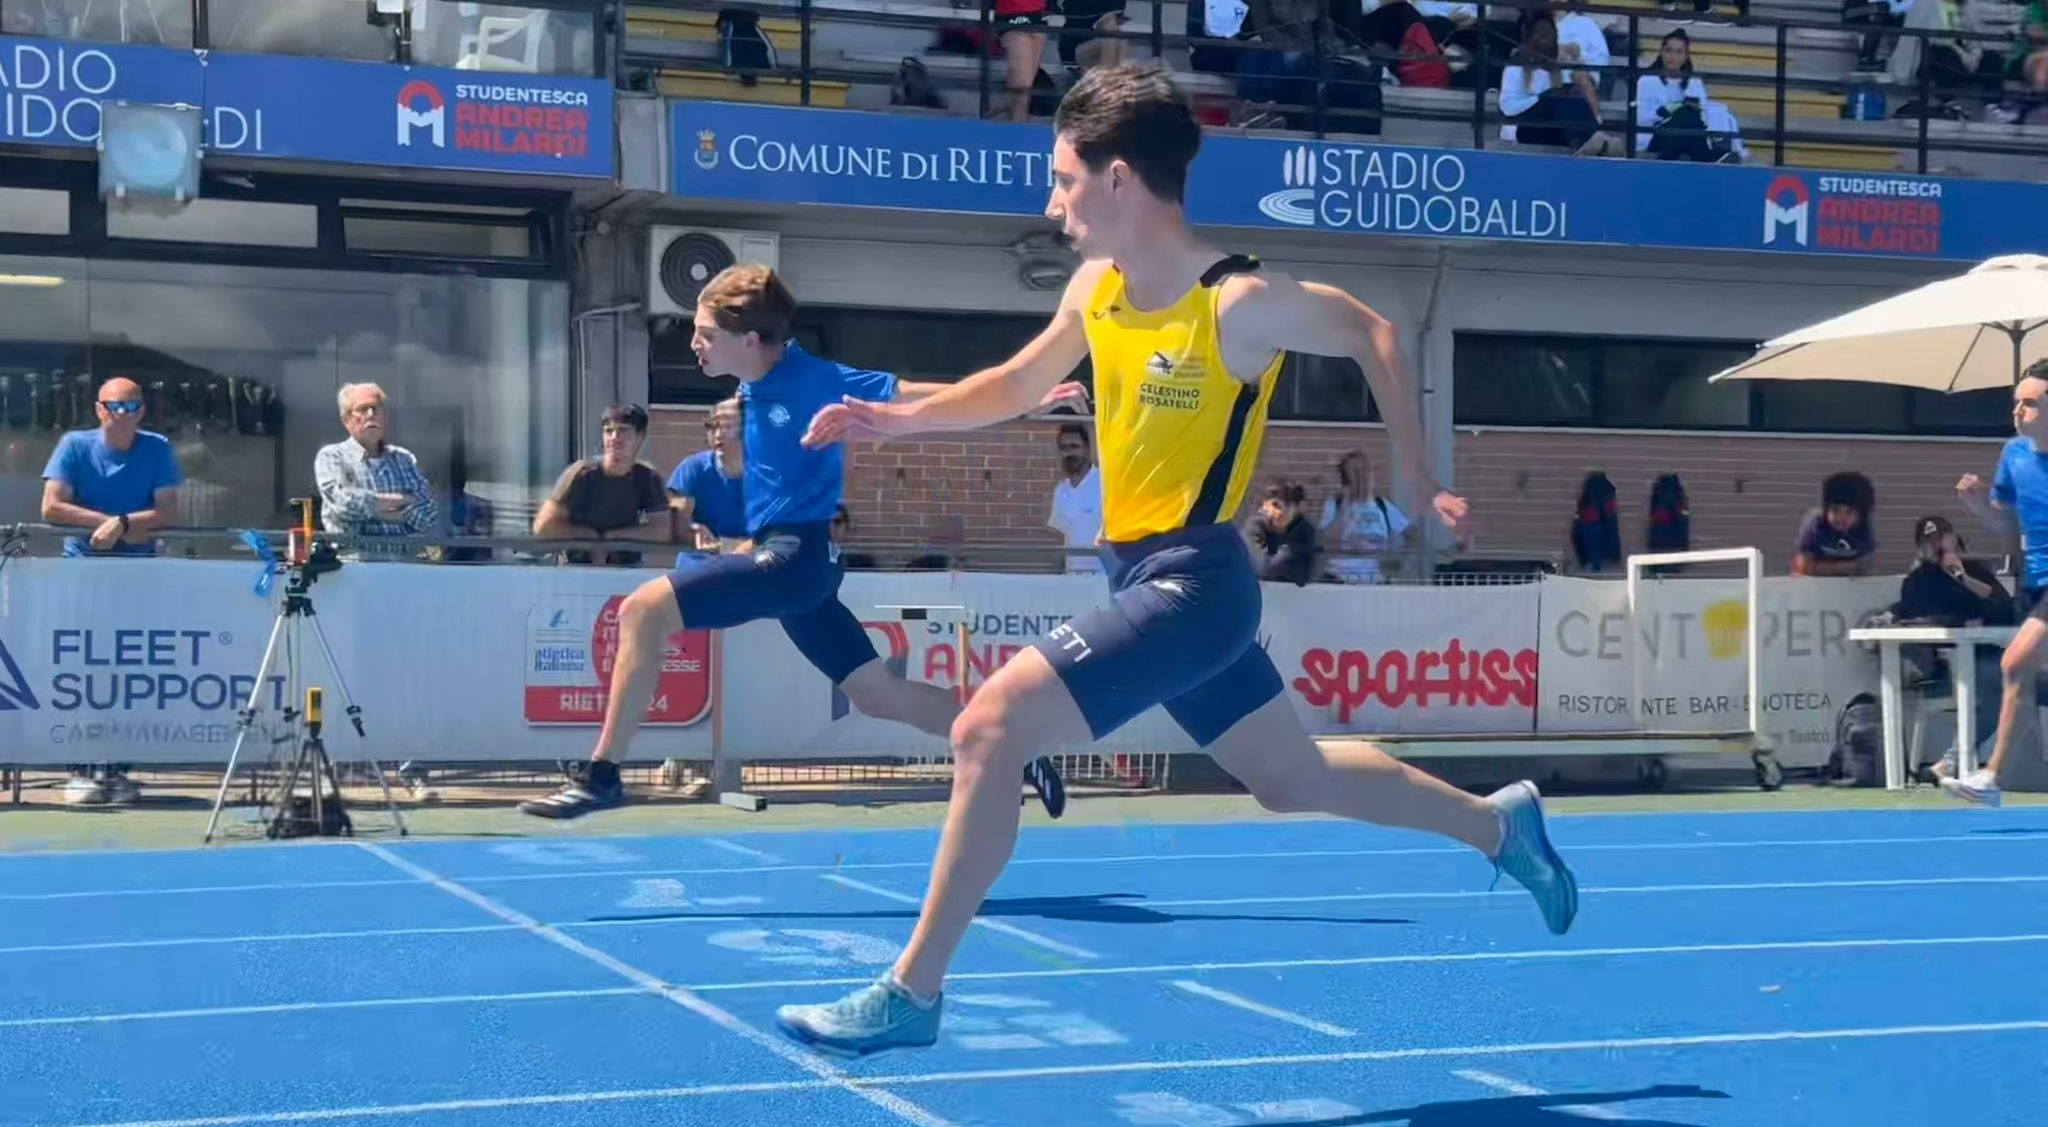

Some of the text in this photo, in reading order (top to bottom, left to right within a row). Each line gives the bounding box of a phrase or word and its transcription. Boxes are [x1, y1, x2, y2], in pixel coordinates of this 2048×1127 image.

[455, 84, 588, 106] STUDENTESCA
[455, 102, 588, 131] ANDREA
[455, 127, 588, 157] MILARDI
[729, 135, 891, 178] COMUNE
[948, 147, 1053, 187] RIETI
[1322, 147, 1465, 192] STADIO
[1818, 176, 1942, 197] STUDENTESCA
[1320, 189, 1567, 237] GUIDOBALDI
[1818, 197, 1941, 225] ANDREA
[1817, 224, 1941, 253] MILARDI
[1139, 394, 1200, 410] ROSATELLI
[1140, 382, 1200, 398] CELESTINO
[52, 629, 211, 666] FLEET
[51, 673, 286, 711] SUPPORT
[560, 693, 610, 713] RIET
[1558, 694, 1677, 715] RISTORNTE
